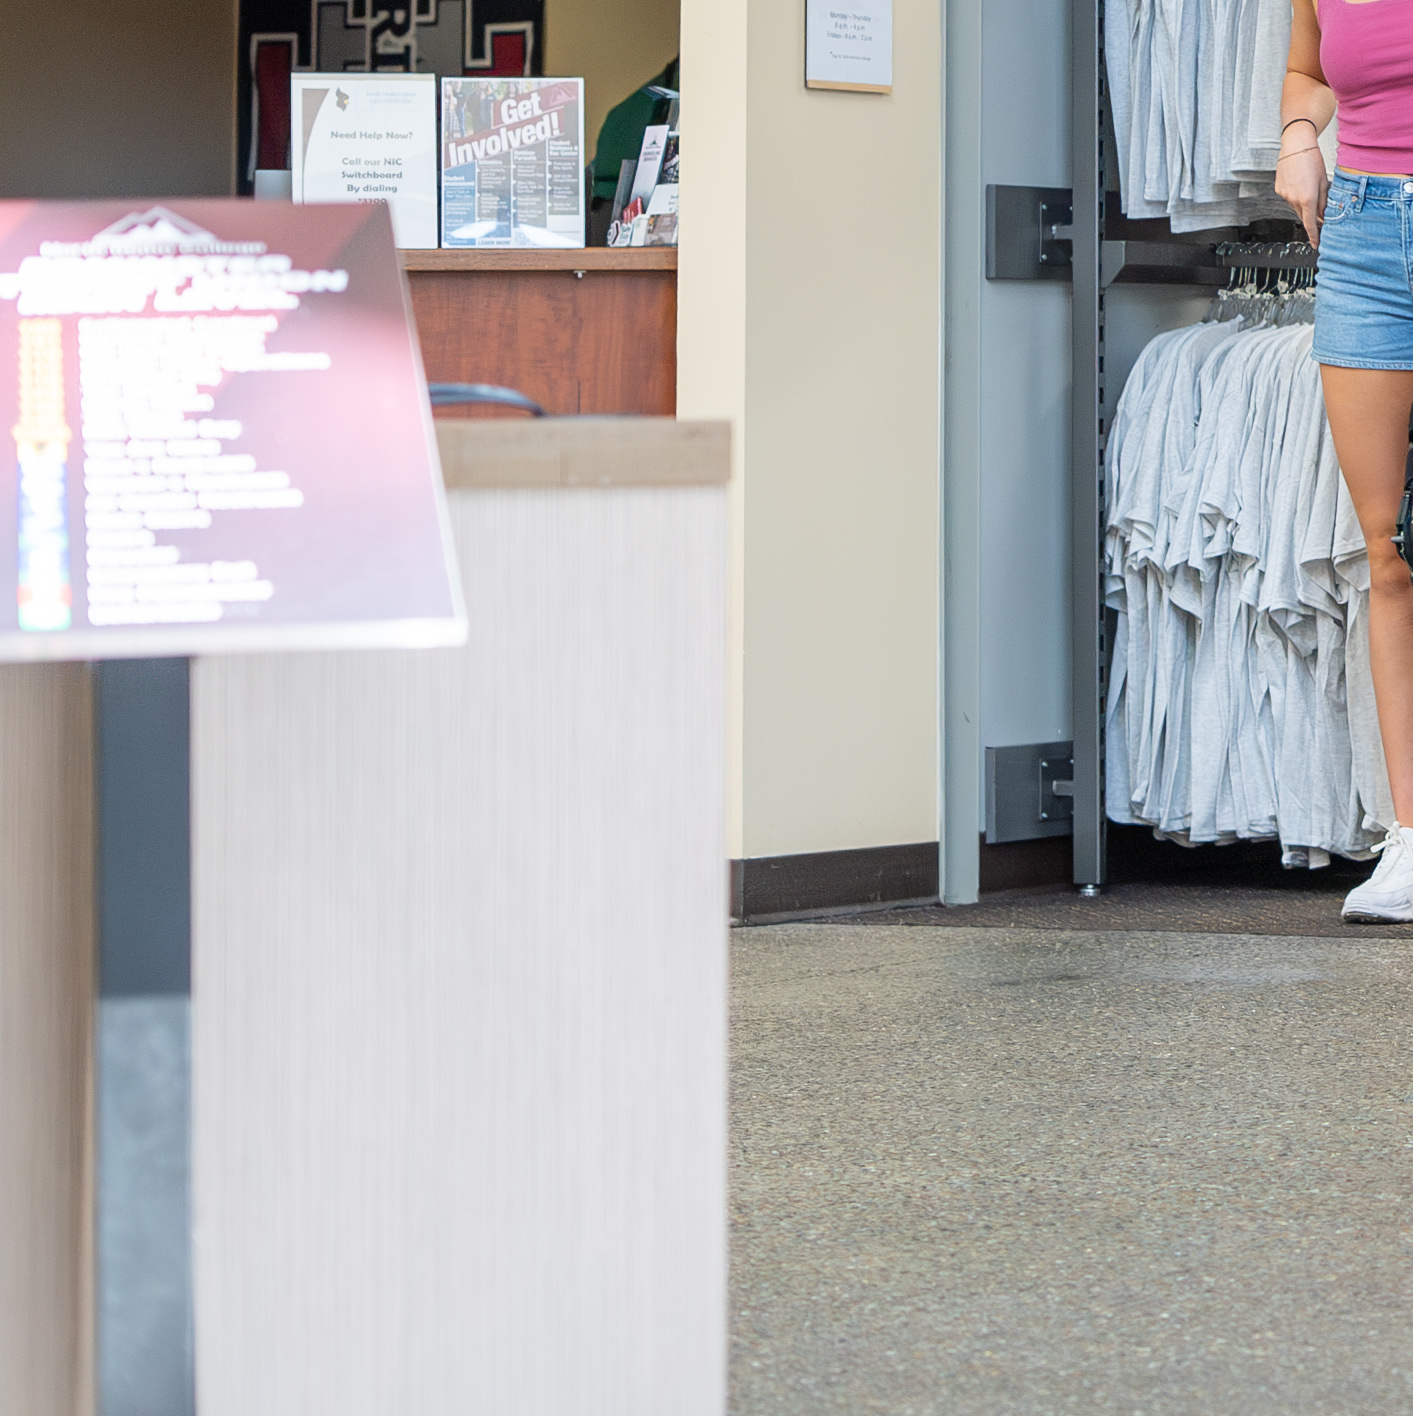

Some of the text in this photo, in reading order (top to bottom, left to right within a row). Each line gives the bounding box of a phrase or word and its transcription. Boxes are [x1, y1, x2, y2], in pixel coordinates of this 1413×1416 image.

[500, 92, 542, 125] Get
[330, 131, 414, 140] Need Help Now?
[449, 112, 560, 167] Involved!
[342, 158, 361, 166] Call
[383, 158, 402, 166] NIC
[342, 171, 402, 179] Switchboard
[346, 184, 398, 194] By dialing
